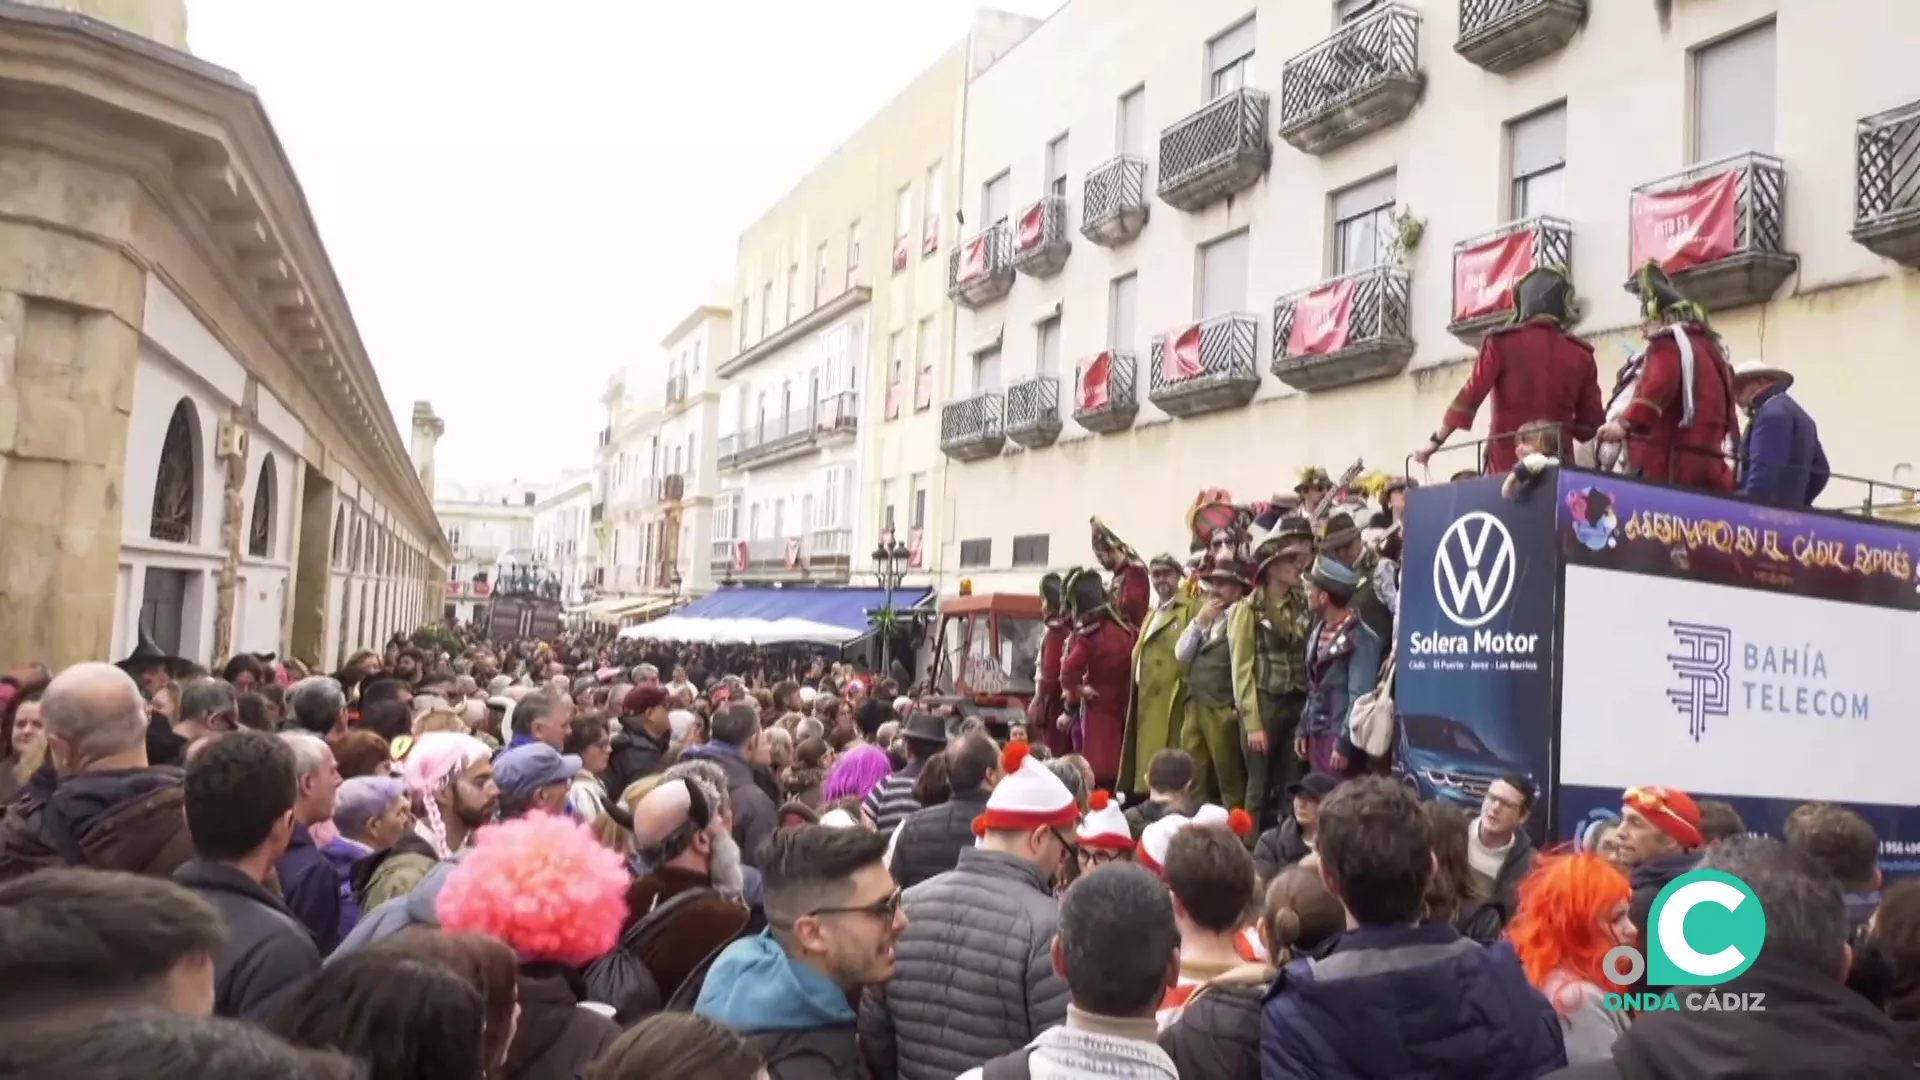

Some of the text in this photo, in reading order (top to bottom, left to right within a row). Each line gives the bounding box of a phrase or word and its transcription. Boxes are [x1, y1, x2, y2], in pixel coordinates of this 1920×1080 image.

[1625, 509, 1911, 581] ASESINATO EN EL CÁDIZ EXPRÉS
[1409, 629, 1538, 655] Solera Motor
[1744, 642, 1828, 679] BAHÍA
[1742, 681, 1869, 721] TELECOM
